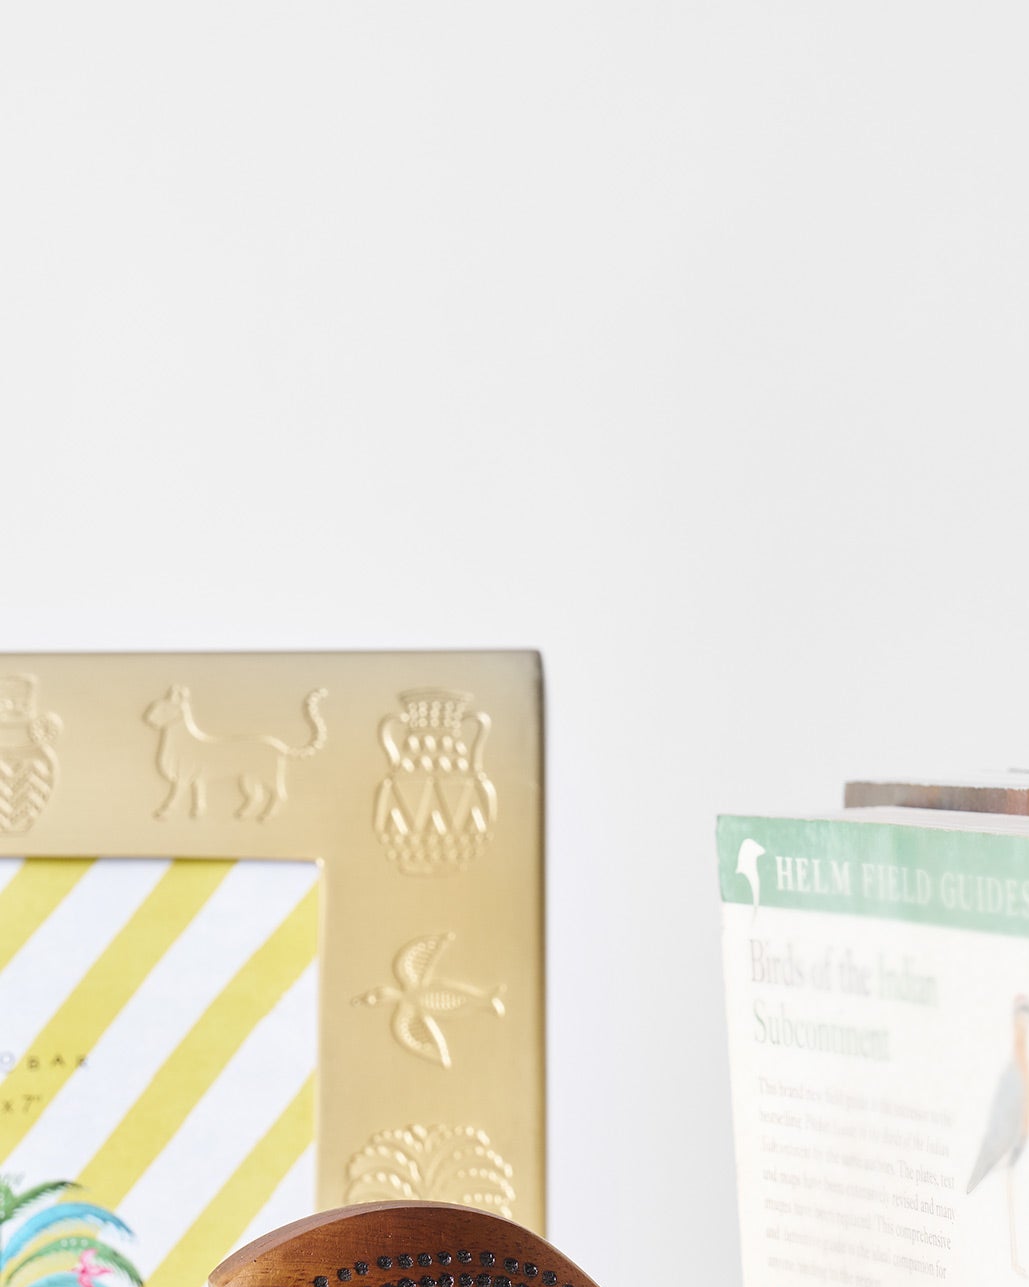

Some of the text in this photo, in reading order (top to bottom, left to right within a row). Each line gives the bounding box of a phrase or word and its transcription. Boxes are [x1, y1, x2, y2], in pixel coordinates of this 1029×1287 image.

[775, 855, 851, 896] HELM
[862, 863, 931, 905] FIELD
[749, 938, 805, 987] Birds
